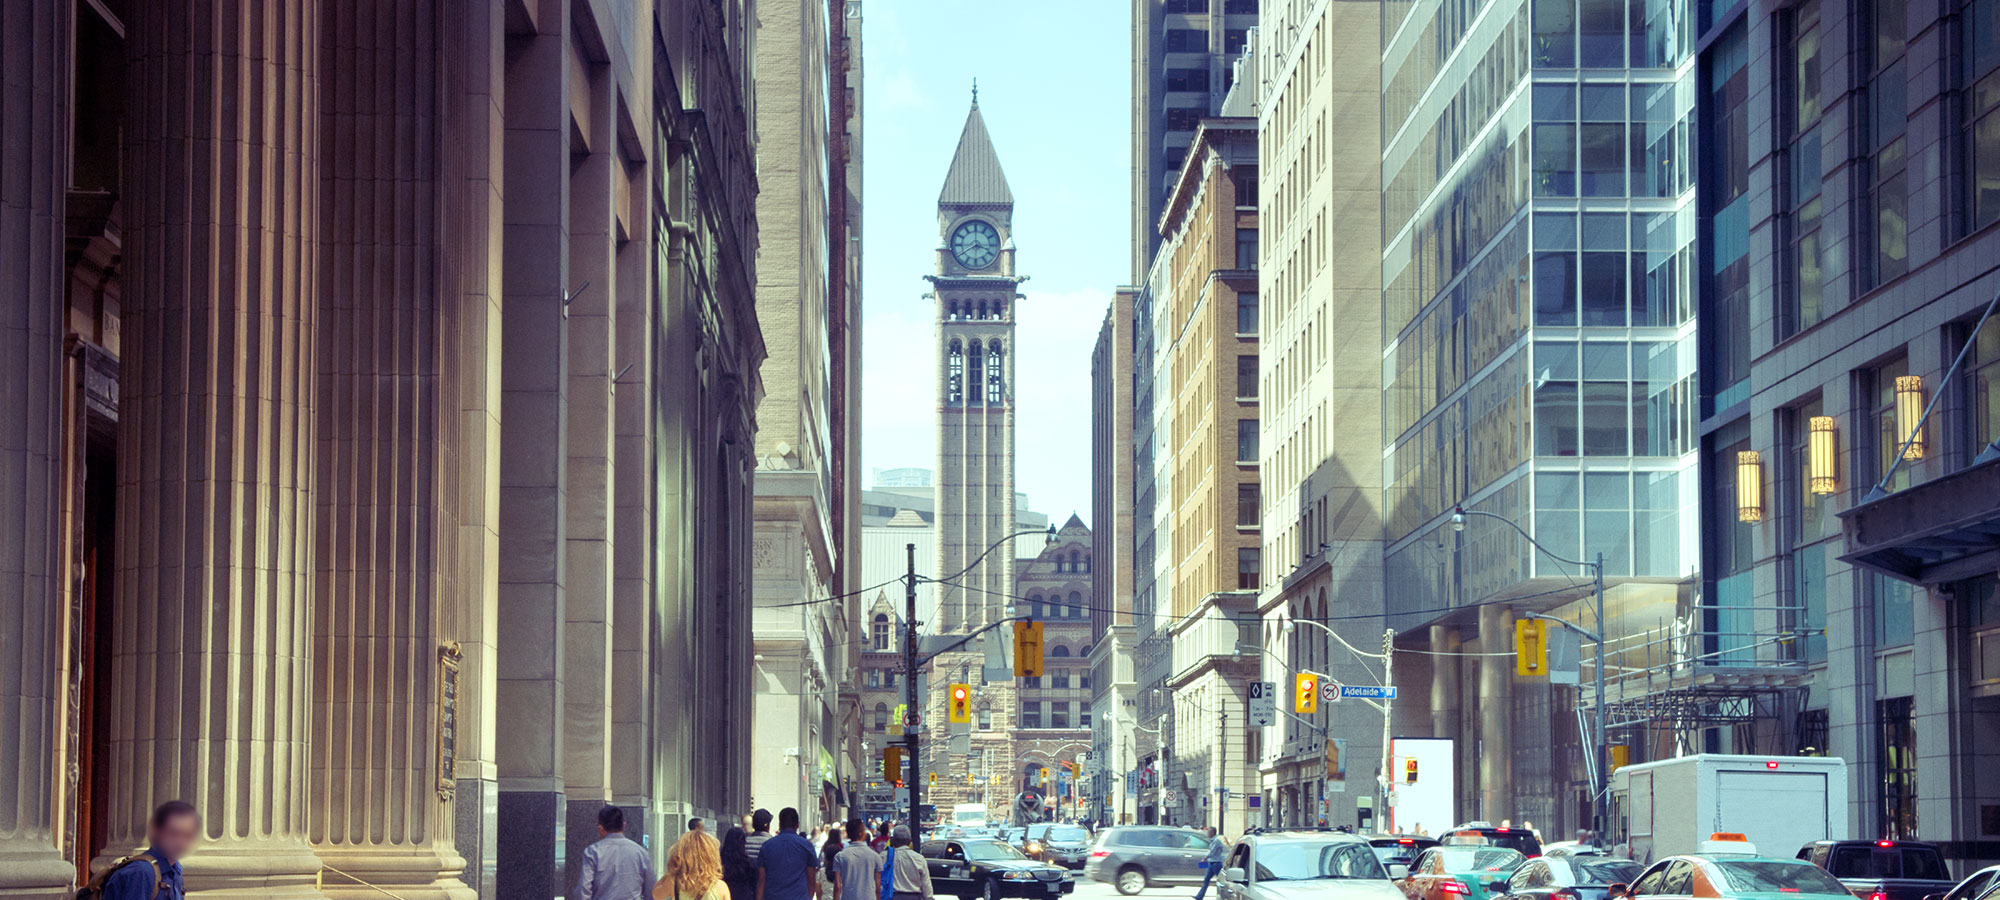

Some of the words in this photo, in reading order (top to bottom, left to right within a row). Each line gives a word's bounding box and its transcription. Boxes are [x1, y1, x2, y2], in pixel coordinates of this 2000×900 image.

[105, 313, 120, 337] BAN
[1344, 687, 1379, 697] Adelaide
[1385, 687, 1393, 697] W
